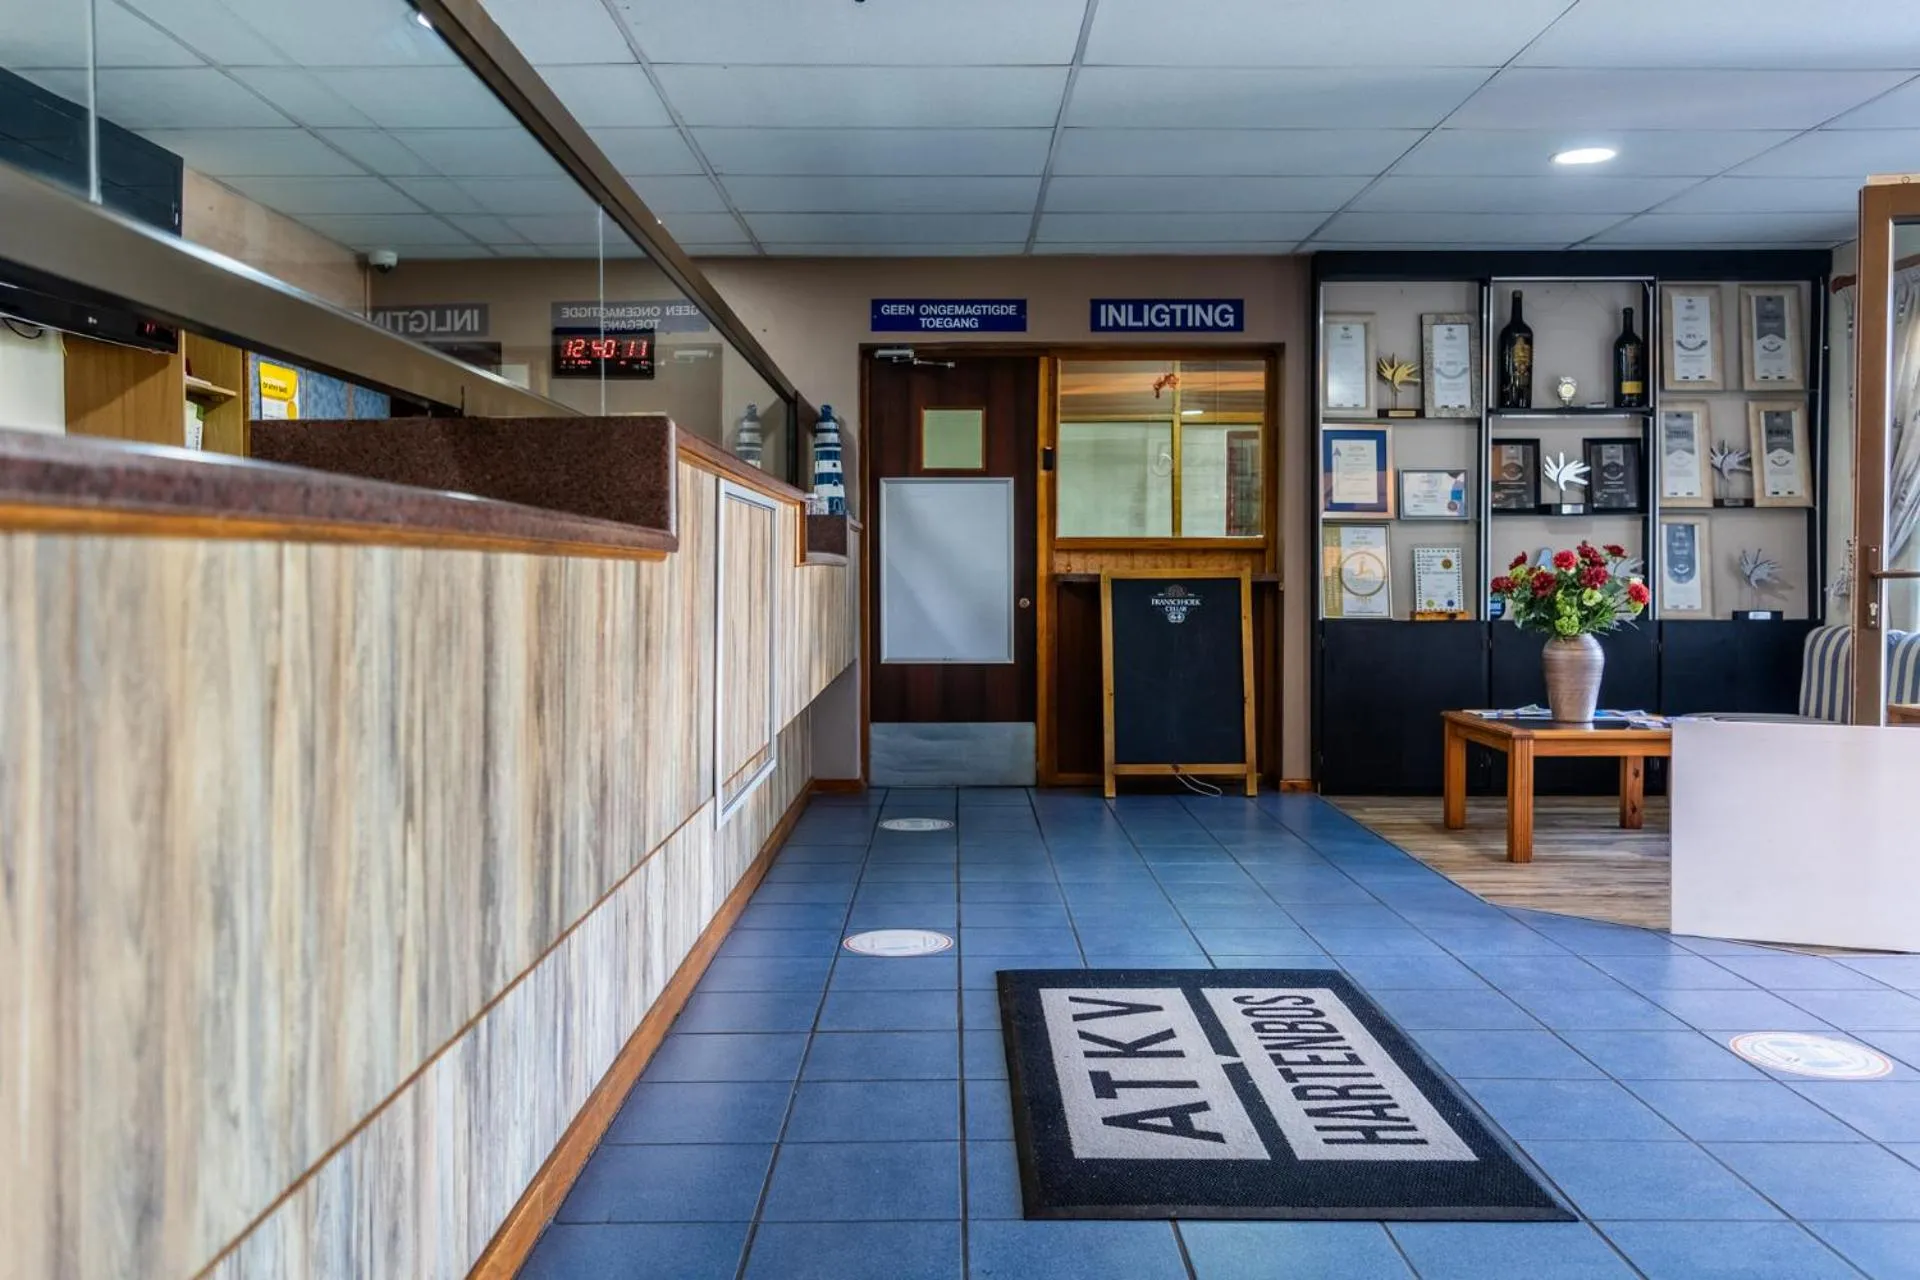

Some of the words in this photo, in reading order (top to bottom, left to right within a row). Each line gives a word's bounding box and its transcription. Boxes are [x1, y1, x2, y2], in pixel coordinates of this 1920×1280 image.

[881, 304, 915, 316] GEEN
[920, 304, 1017, 316] ONGEMAGTIGDE
[1100, 303, 1235, 328] INLIGTING
[920, 317, 979, 329] TOEGANG
[1068, 995, 1226, 1144] ATKV
[1232, 994, 1429, 1146] HARTENBOS
